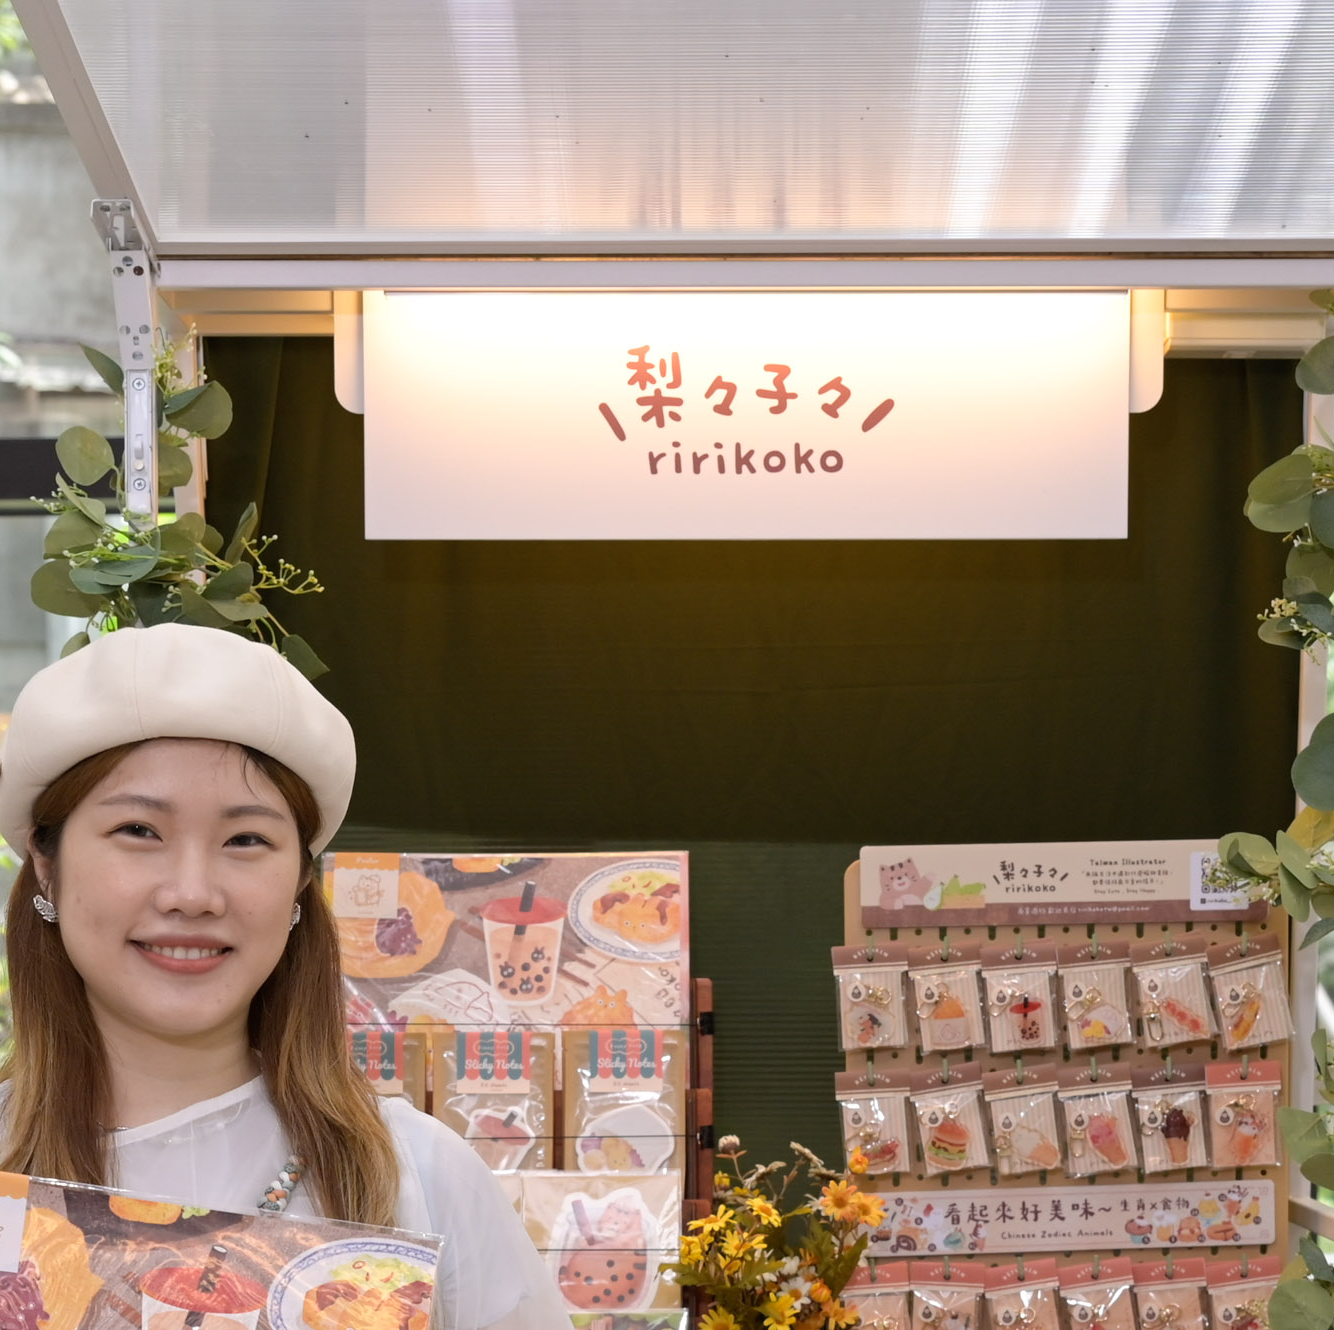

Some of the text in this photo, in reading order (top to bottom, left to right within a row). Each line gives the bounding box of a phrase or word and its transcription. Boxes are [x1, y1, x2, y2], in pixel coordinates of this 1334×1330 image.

[627, 345, 852, 428] 梨々子々
[648, 441, 844, 475] ririkoko
[1000, 860, 1058, 881] 梨々子々
[1005, 883, 1056, 893] ririkoko
[369, 1060, 397, 1071] Notes
[465, 1058, 523, 1074] Sticky Notes
[597, 1057, 656, 1073] Sticky Notes
[944, 1197, 1112, 1225] 看起來好美味~
[1001, 1228, 1114, 1240] Chinese Zodiac Animals
